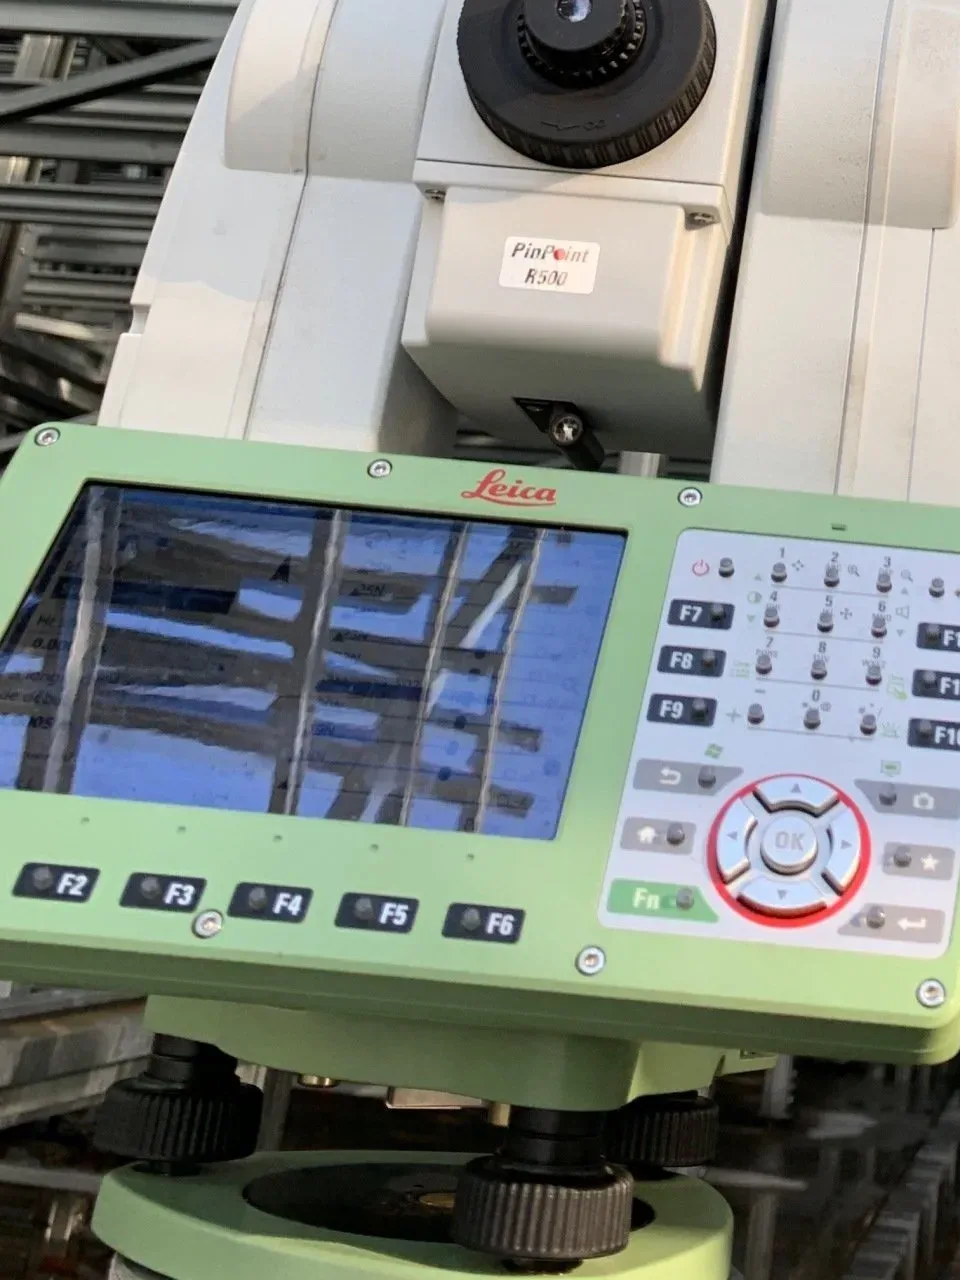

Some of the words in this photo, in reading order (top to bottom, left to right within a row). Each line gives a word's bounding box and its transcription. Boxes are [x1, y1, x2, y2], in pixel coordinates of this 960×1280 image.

[524, 268, 568, 287] R500
[461, 469, 557, 506] Leica
[831, 551, 839, 562] 2
[883, 556, 891, 567] 3
[769, 591, 778, 602] 4
[825, 595, 833, 607] 5
[678, 605, 703, 622] F7
[878, 601, 886, 612] 6
[766, 636, 774, 649] 7
[818, 641, 827, 653] 8
[872, 646, 881, 658] 9
[669, 651, 694, 670] F8
[811, 689, 820, 702] 0
[658, 699, 684, 719] F9
[774, 831, 805, 851] OK
[56, 873, 89, 896] F2
[164, 883, 194, 907] F3
[632, 889, 661, 911] Fn
[272, 893, 304, 917] F4
[378, 903, 408, 927] F5
[486, 913, 515, 937] F6
